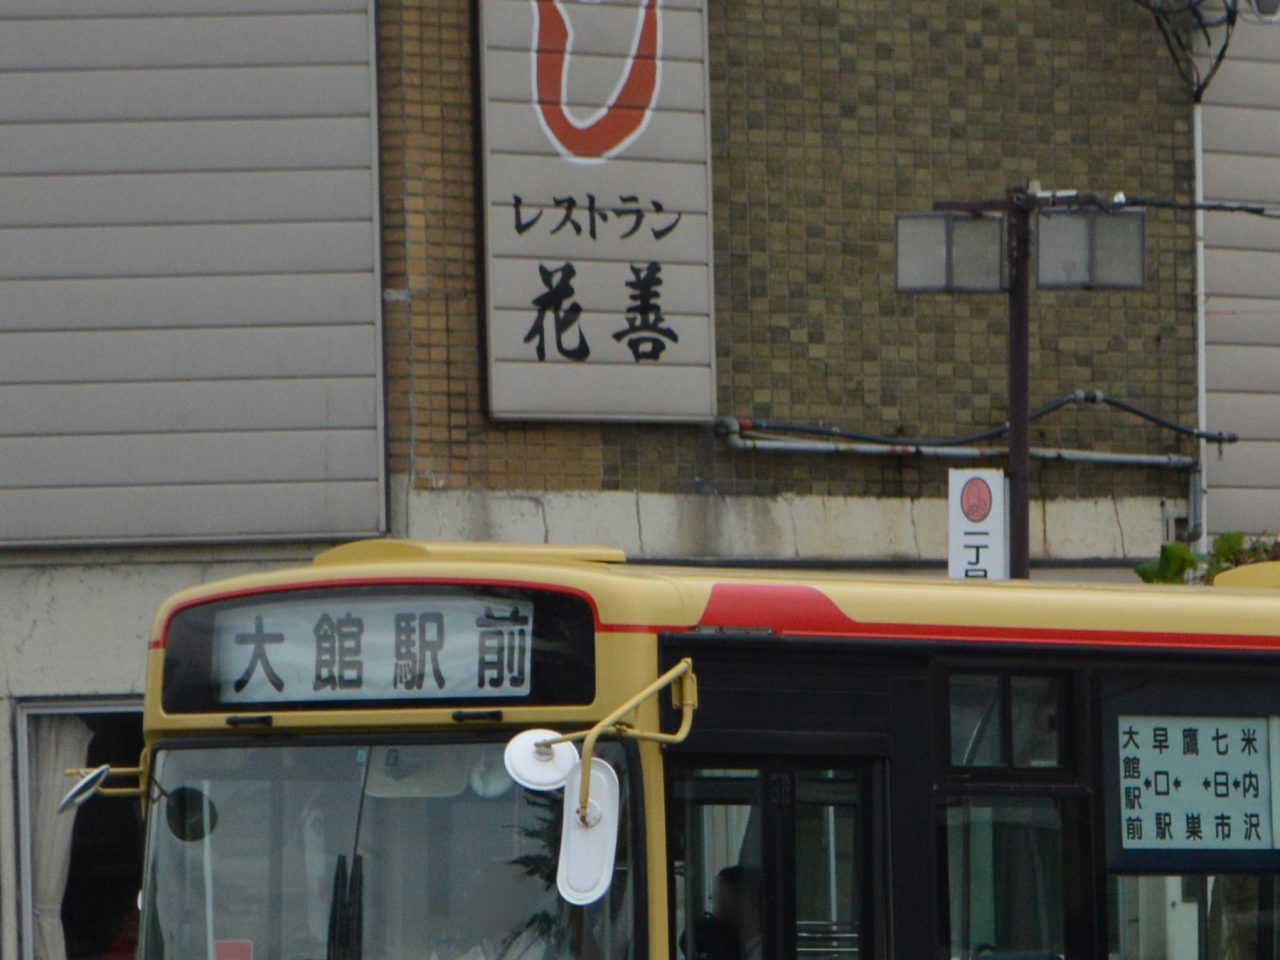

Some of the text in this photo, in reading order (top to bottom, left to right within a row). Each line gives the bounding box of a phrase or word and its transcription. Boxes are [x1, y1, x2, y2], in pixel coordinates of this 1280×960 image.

[512, 194, 682, 240] レストラン
[524, 262, 679, 362] 花善
[233, 606, 529, 693] 大館駅前
[1122, 726, 1143, 840] 大館駅前
[1152, 727, 1173, 840] 早口駅
[1182, 728, 1203, 840] 鷹巣
[1211, 728, 1232, 840] 七日市
[1241, 728, 1261, 840] 米内沢
